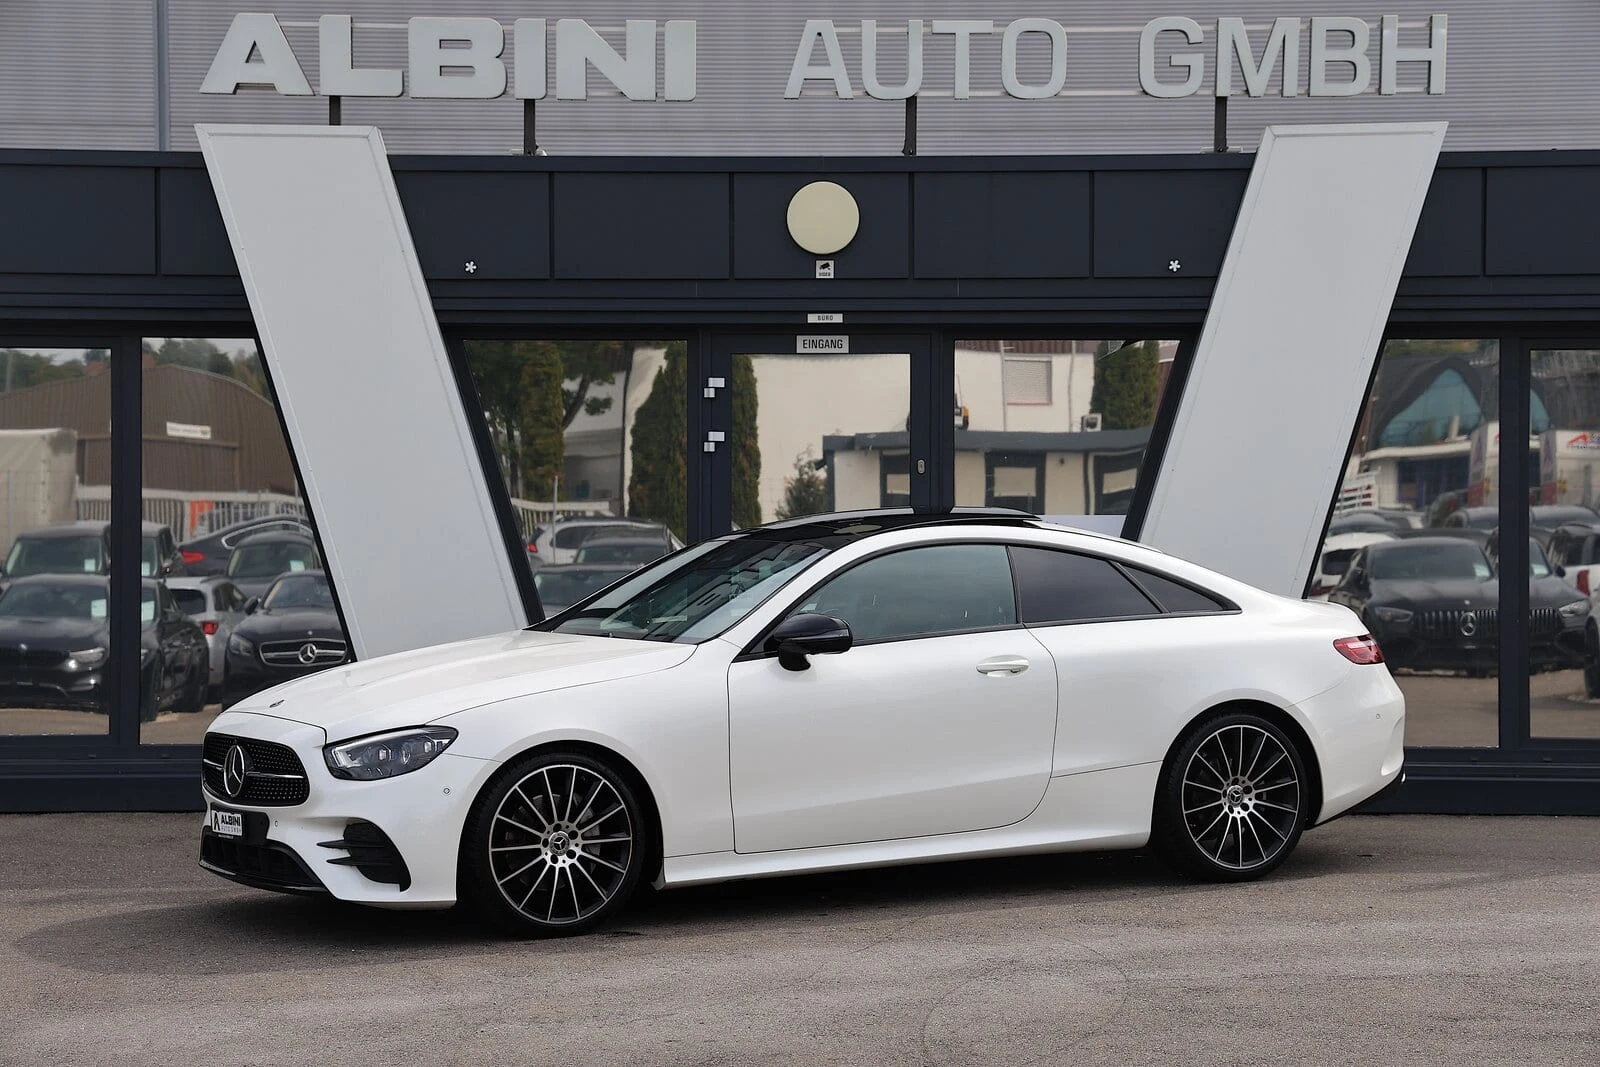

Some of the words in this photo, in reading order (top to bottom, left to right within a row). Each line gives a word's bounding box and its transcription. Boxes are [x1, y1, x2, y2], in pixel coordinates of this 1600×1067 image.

[199, 12, 697, 102] ALBINI
[783, 17, 1068, 101] AUTO
[1138, 13, 1448, 99] GMBH
[802, 339, 843, 349] EINGANG
[220, 814, 241, 827] ALBINI
